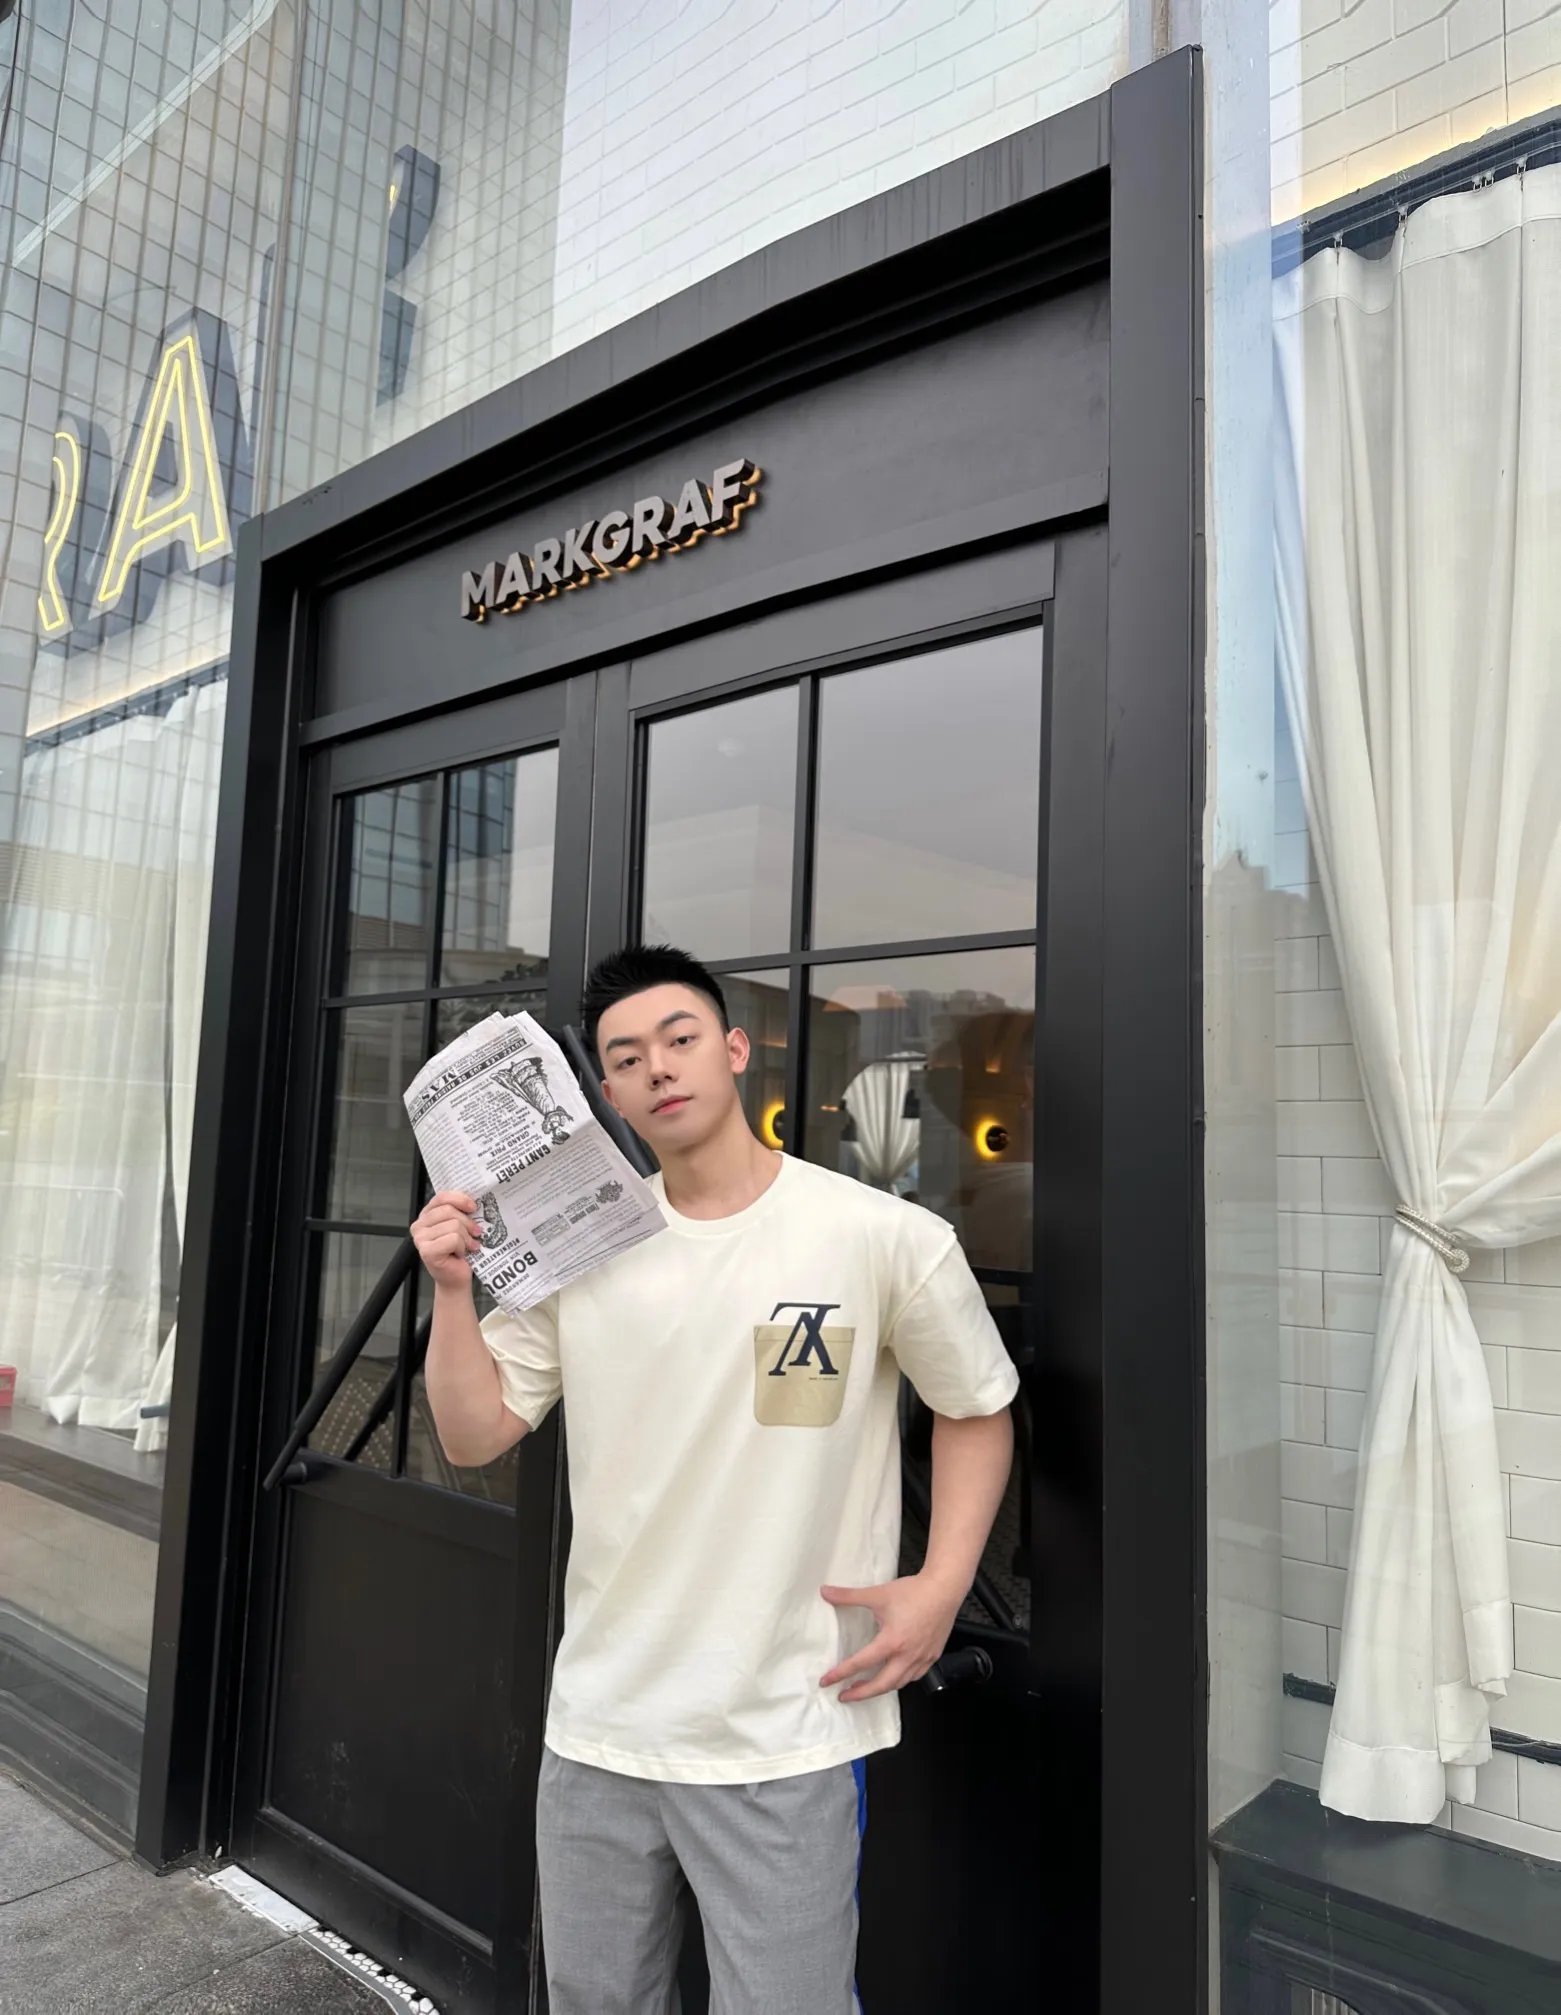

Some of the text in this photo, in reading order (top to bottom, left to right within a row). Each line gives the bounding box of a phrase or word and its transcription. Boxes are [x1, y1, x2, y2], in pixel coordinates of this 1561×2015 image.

[460, 457, 759, 621] MARKGRAF
[485, 1054, 500, 1065] LES
[468, 1064, 483, 1075] JUS
[420, 1068, 457, 1101] MAS
[506, 1130, 529, 1147] GRAND
[489, 1144, 506, 1157] PRIX
[523, 1143, 550, 1165] GANT
[494, 1159, 525, 1184] PERÊT
